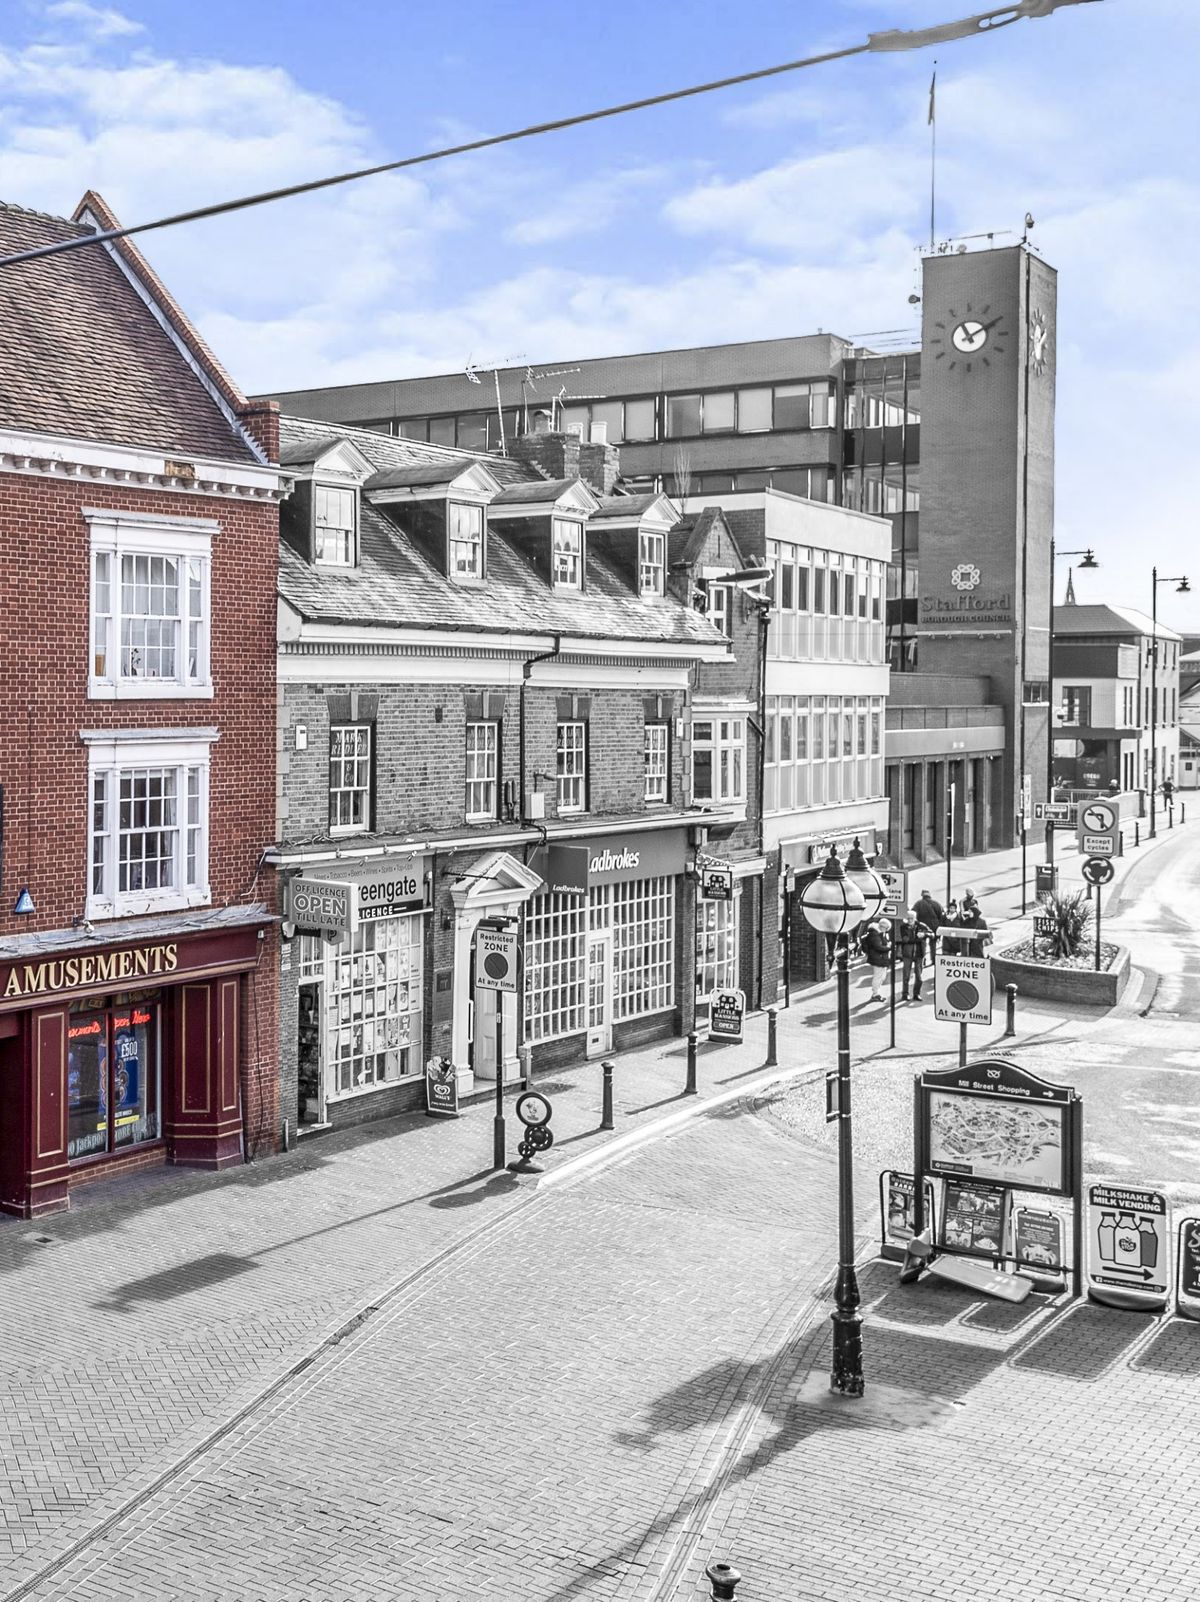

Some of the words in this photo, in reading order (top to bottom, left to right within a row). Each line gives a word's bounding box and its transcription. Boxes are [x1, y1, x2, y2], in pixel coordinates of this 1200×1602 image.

[921, 593, 1010, 612] Stafford
[921, 615, 967, 624] BOROUGH
[969, 614, 1011, 623] COUNCIL
[295, 884, 311, 893] OFF
[312, 886, 346, 898] LICENCE
[358, 876, 417, 902] eengate
[552, 884, 585, 893] Ladbrokes
[294, 894, 347, 918] OPEN
[296, 913, 317, 923] TILL
[320, 916, 345, 927] LATE
[1038, 918, 1055, 926] FISH
[1038, 924, 1059, 932] CHIPS
[480, 933, 514, 943] Restricted
[484, 942, 508, 952] ZONE
[3, 943, 179, 997] AMUSEMENTS
[940, 958, 985, 969] Restricted
[946, 969, 978, 980] ZONE
[114, 1016, 130, 1032] pen
[132, 1010, 151, 1025] Now
[969, 1012, 988, 1020] time
[121, 1041, 138, 1058] £500
[972, 1082, 994, 1090] Street
[998, 1085, 1030, 1096] Shopping
[1093, 1188, 1150, 1202] MILKSHAKE
[1152, 1196, 1160, 1204] &
[1093, 1196, 1117, 1206] MILK
[1118, 1200, 1161, 1212] VENDING
